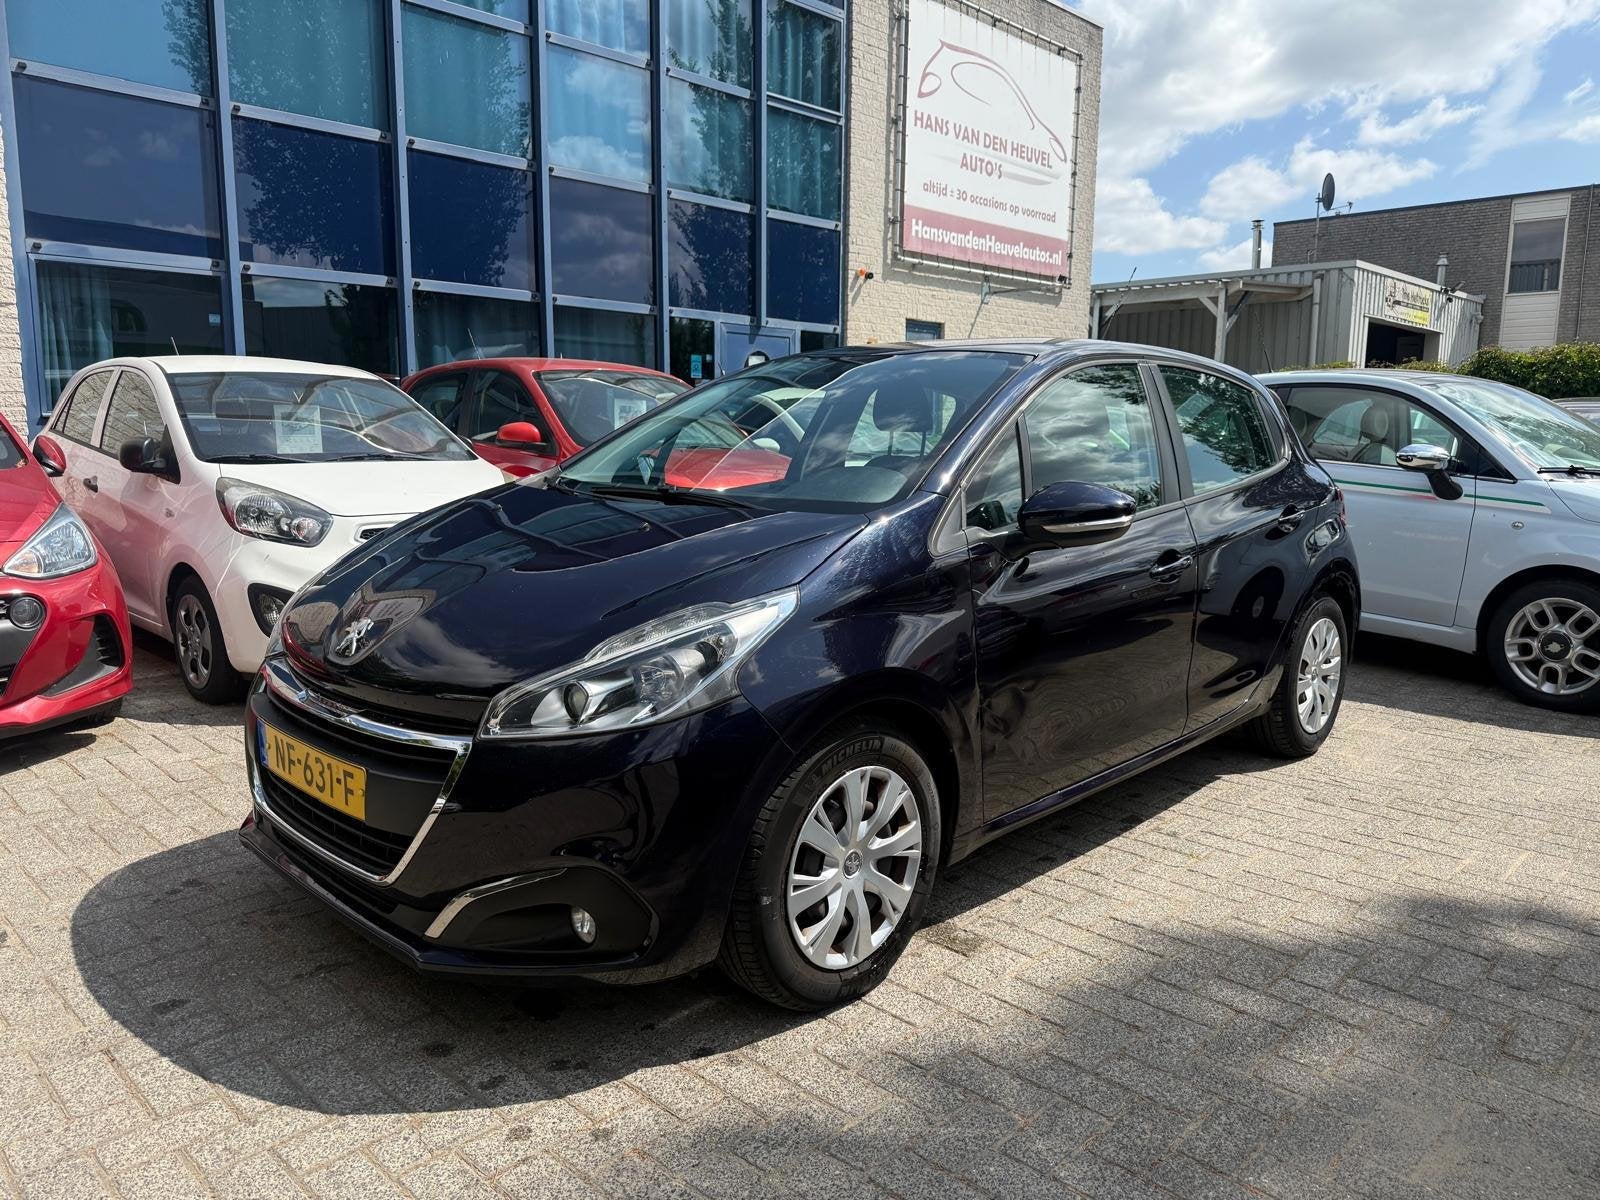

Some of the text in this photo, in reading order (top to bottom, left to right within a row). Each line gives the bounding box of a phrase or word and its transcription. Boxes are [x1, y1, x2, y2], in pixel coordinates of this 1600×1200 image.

[914, 109, 1053, 169] HANS VAN DEN HEUVEL
[960, 152, 1003, 180] AUTO'S
[922, 180, 948, 198] altijd
[956, 188, 968, 202] 30
[969, 193, 1008, 212] occasions
[1009, 203, 1020, 216] op
[1021, 206, 1057, 223] voorraad
[911, 218, 1063, 266] HansvandenHeuvelautos.nl
[274, 734, 355, 807] NF-631-F
[821, 738, 883, 775] MICHELIN
